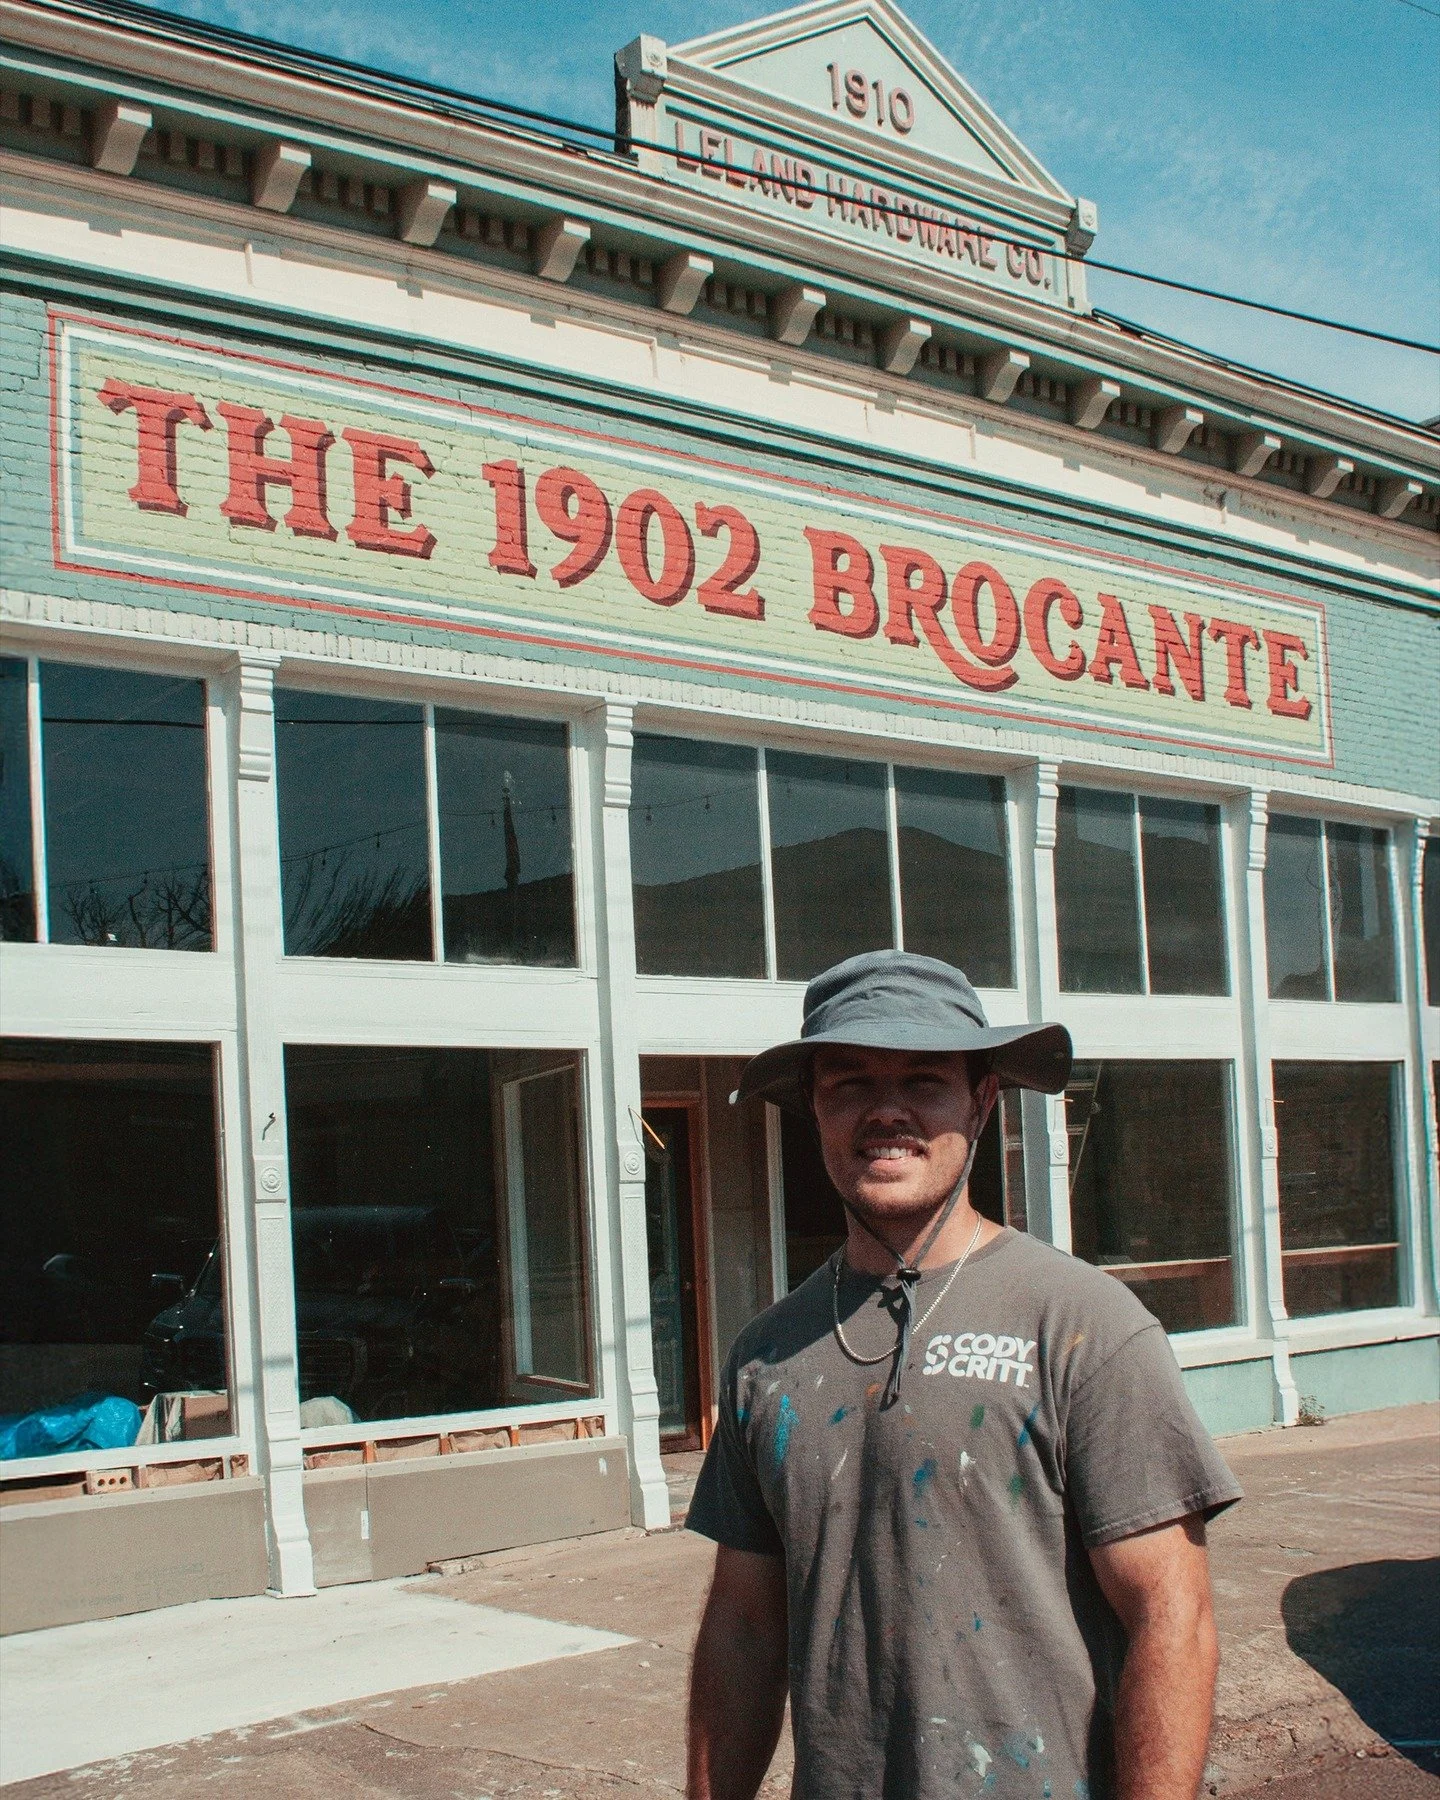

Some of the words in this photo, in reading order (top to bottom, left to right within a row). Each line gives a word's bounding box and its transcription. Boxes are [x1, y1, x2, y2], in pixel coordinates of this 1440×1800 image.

[826, 62, 915, 134] 1910
[674, 121, 816, 208] LELAND
[826, 172, 998, 271] HARDWARE
[97, 378, 438, 559] THE
[481, 459, 766, 621] 1902
[803, 526, 1311, 720] BROCANTE
[953, 1332, 1037, 1362] CODY
